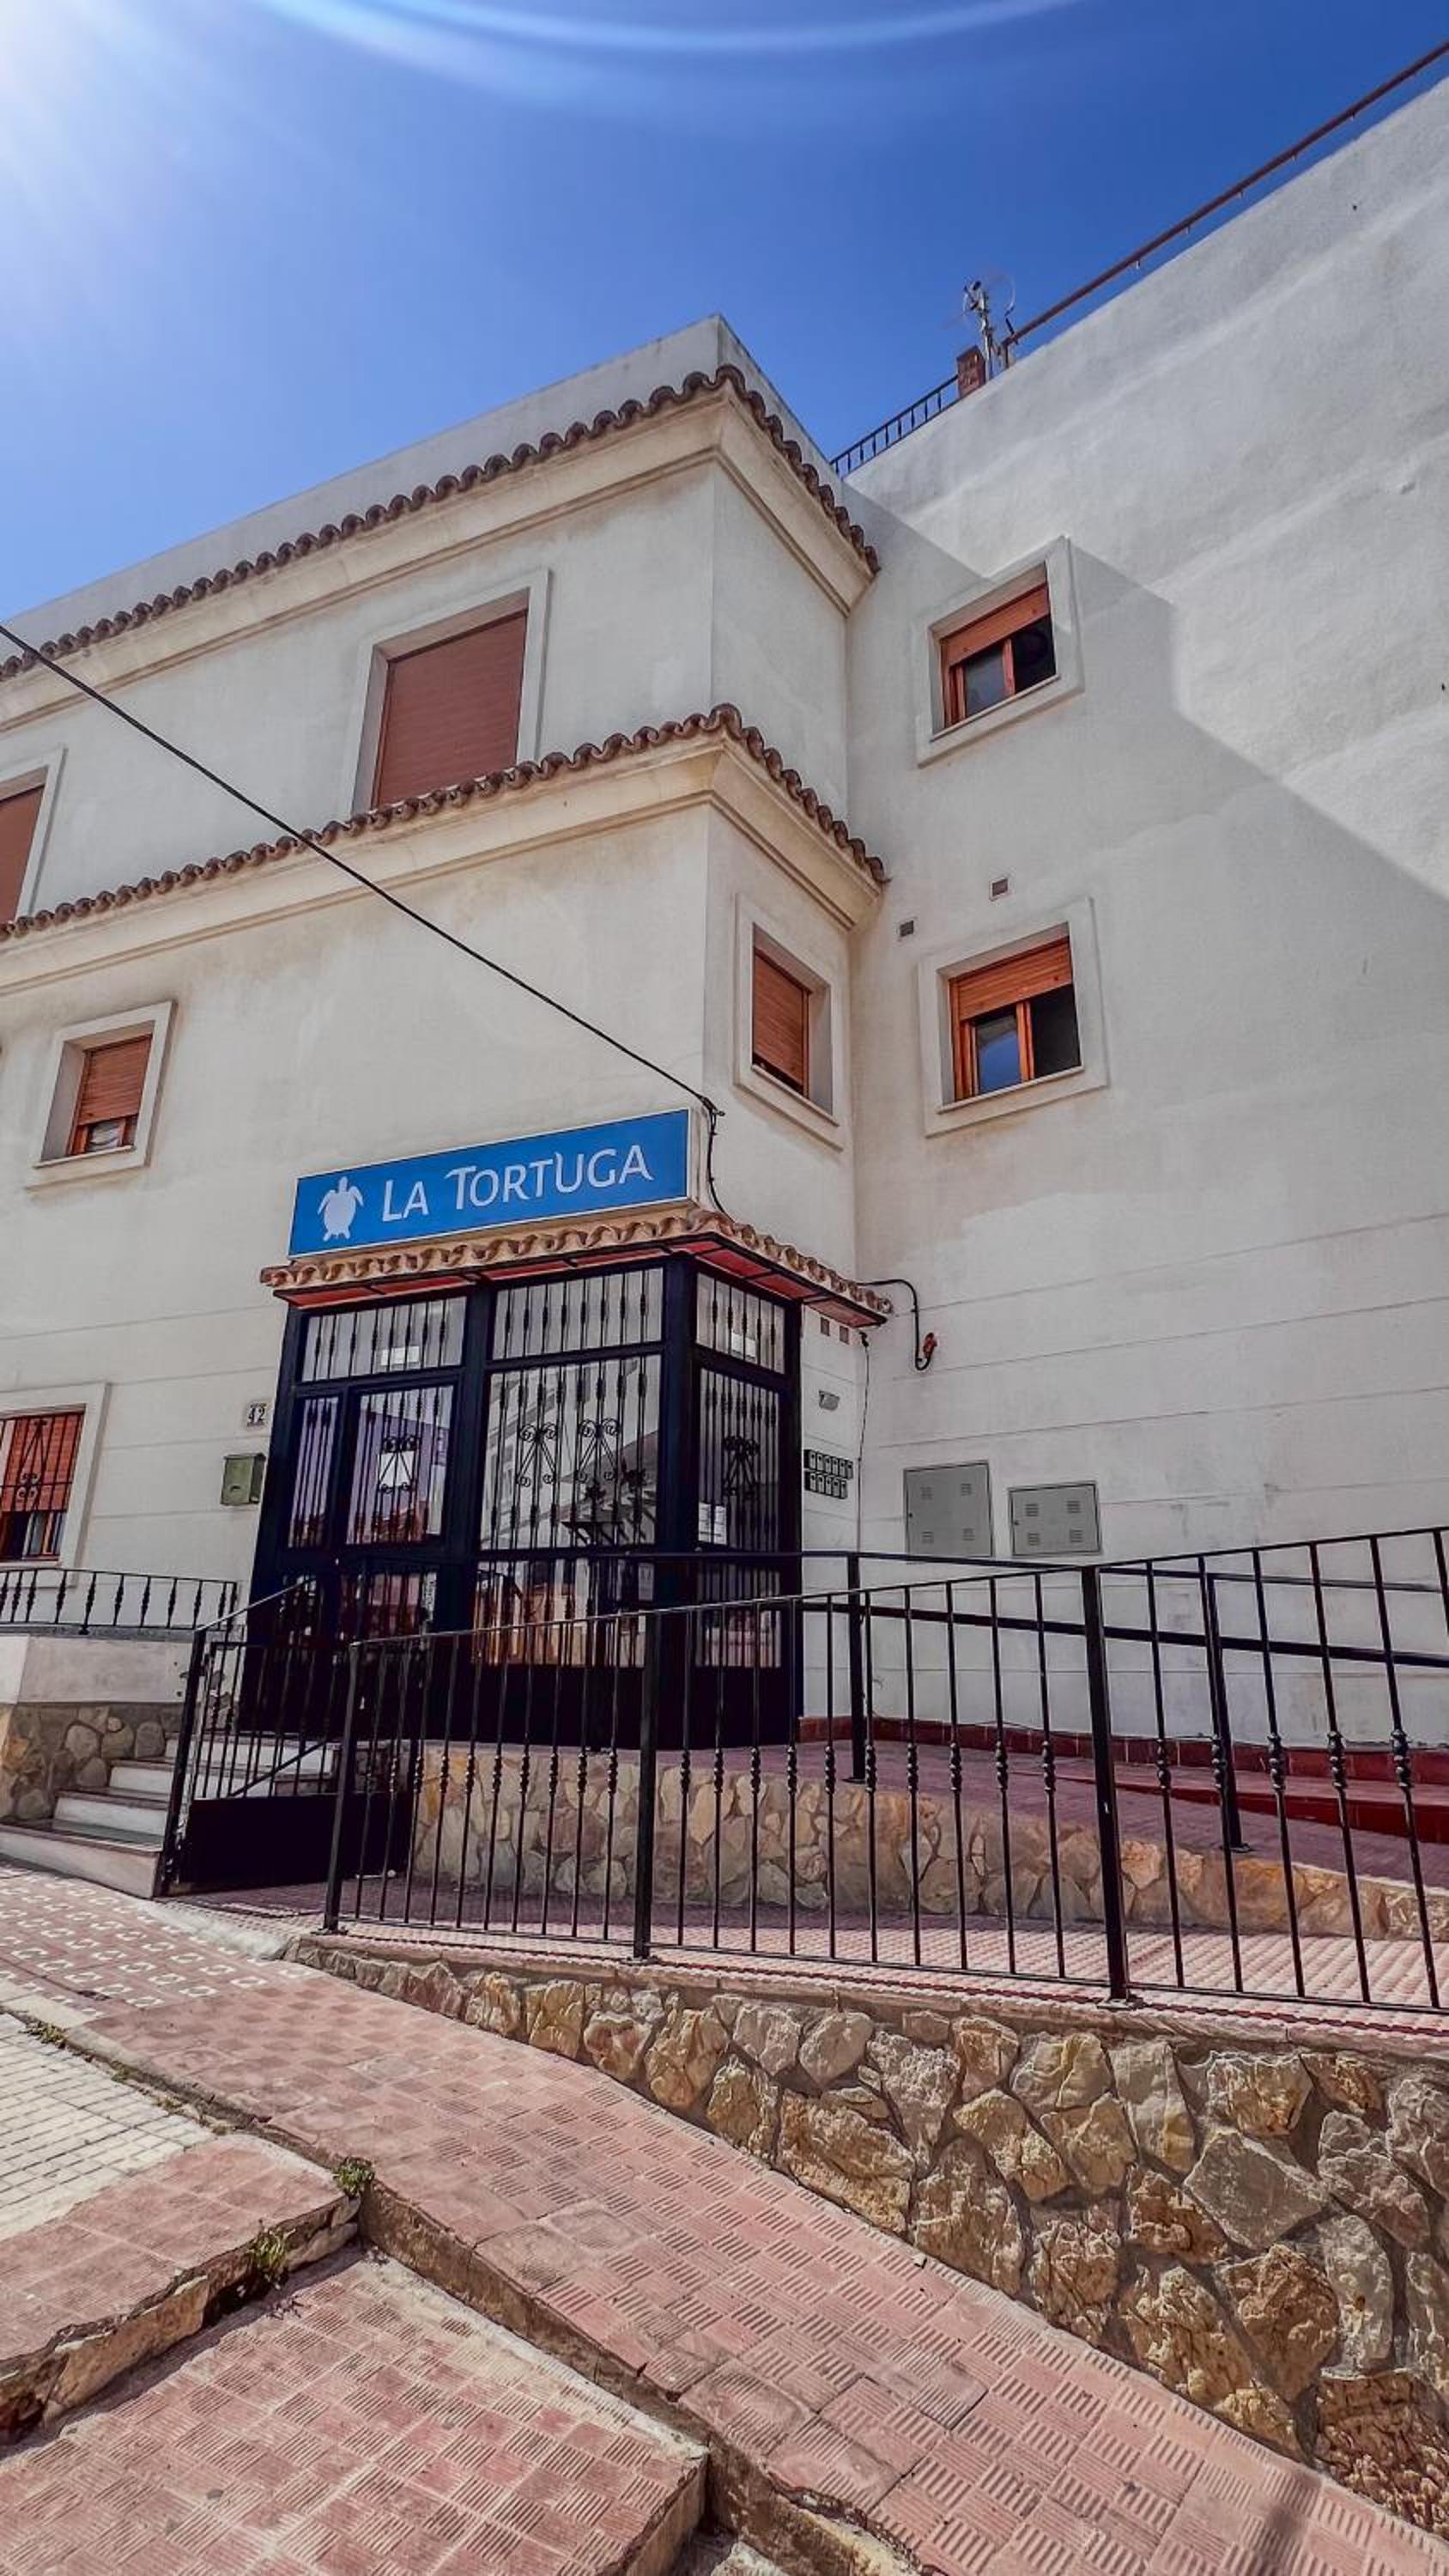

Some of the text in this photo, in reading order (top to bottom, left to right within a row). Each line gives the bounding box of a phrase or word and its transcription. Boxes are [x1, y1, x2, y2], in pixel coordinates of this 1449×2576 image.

[382, 1145, 654, 1221] LA TORTUGA
[248, 1406, 266, 1423] 42
